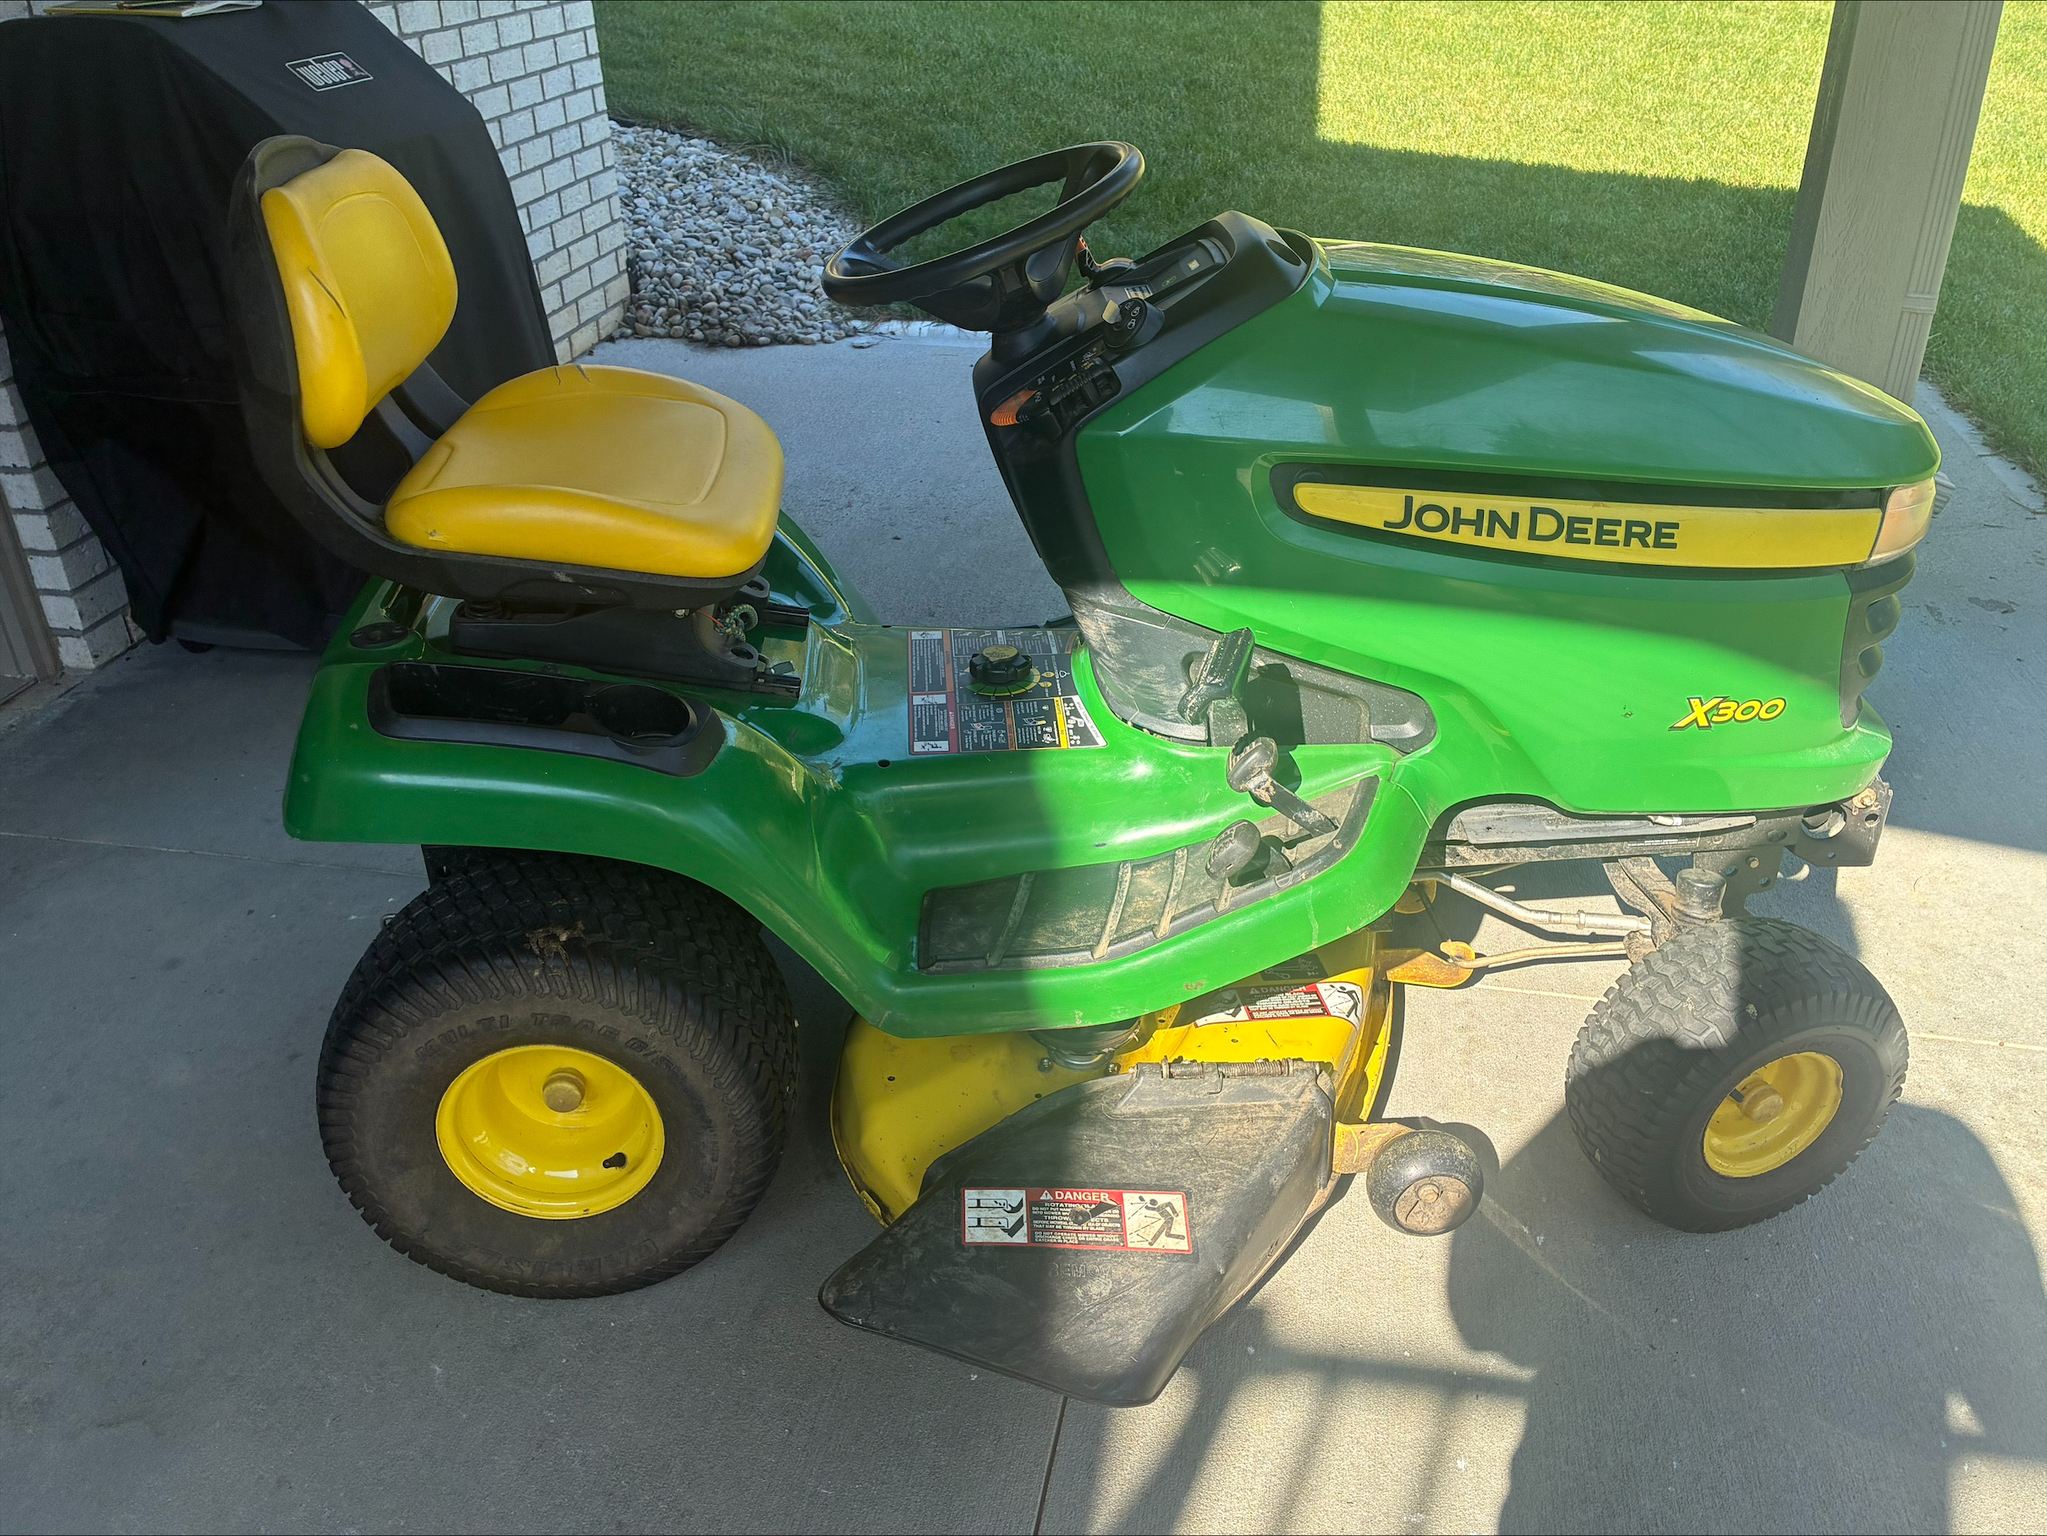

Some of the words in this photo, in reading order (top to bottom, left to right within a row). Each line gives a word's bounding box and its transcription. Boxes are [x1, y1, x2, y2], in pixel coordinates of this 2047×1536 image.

[295, 59, 352, 86] weber
[1383, 495, 1520, 540] JOHN
[1527, 506, 1680, 550] DEERE
[1667, 695, 1788, 731] X300
[1055, 1190, 1110, 1202] DANGER
